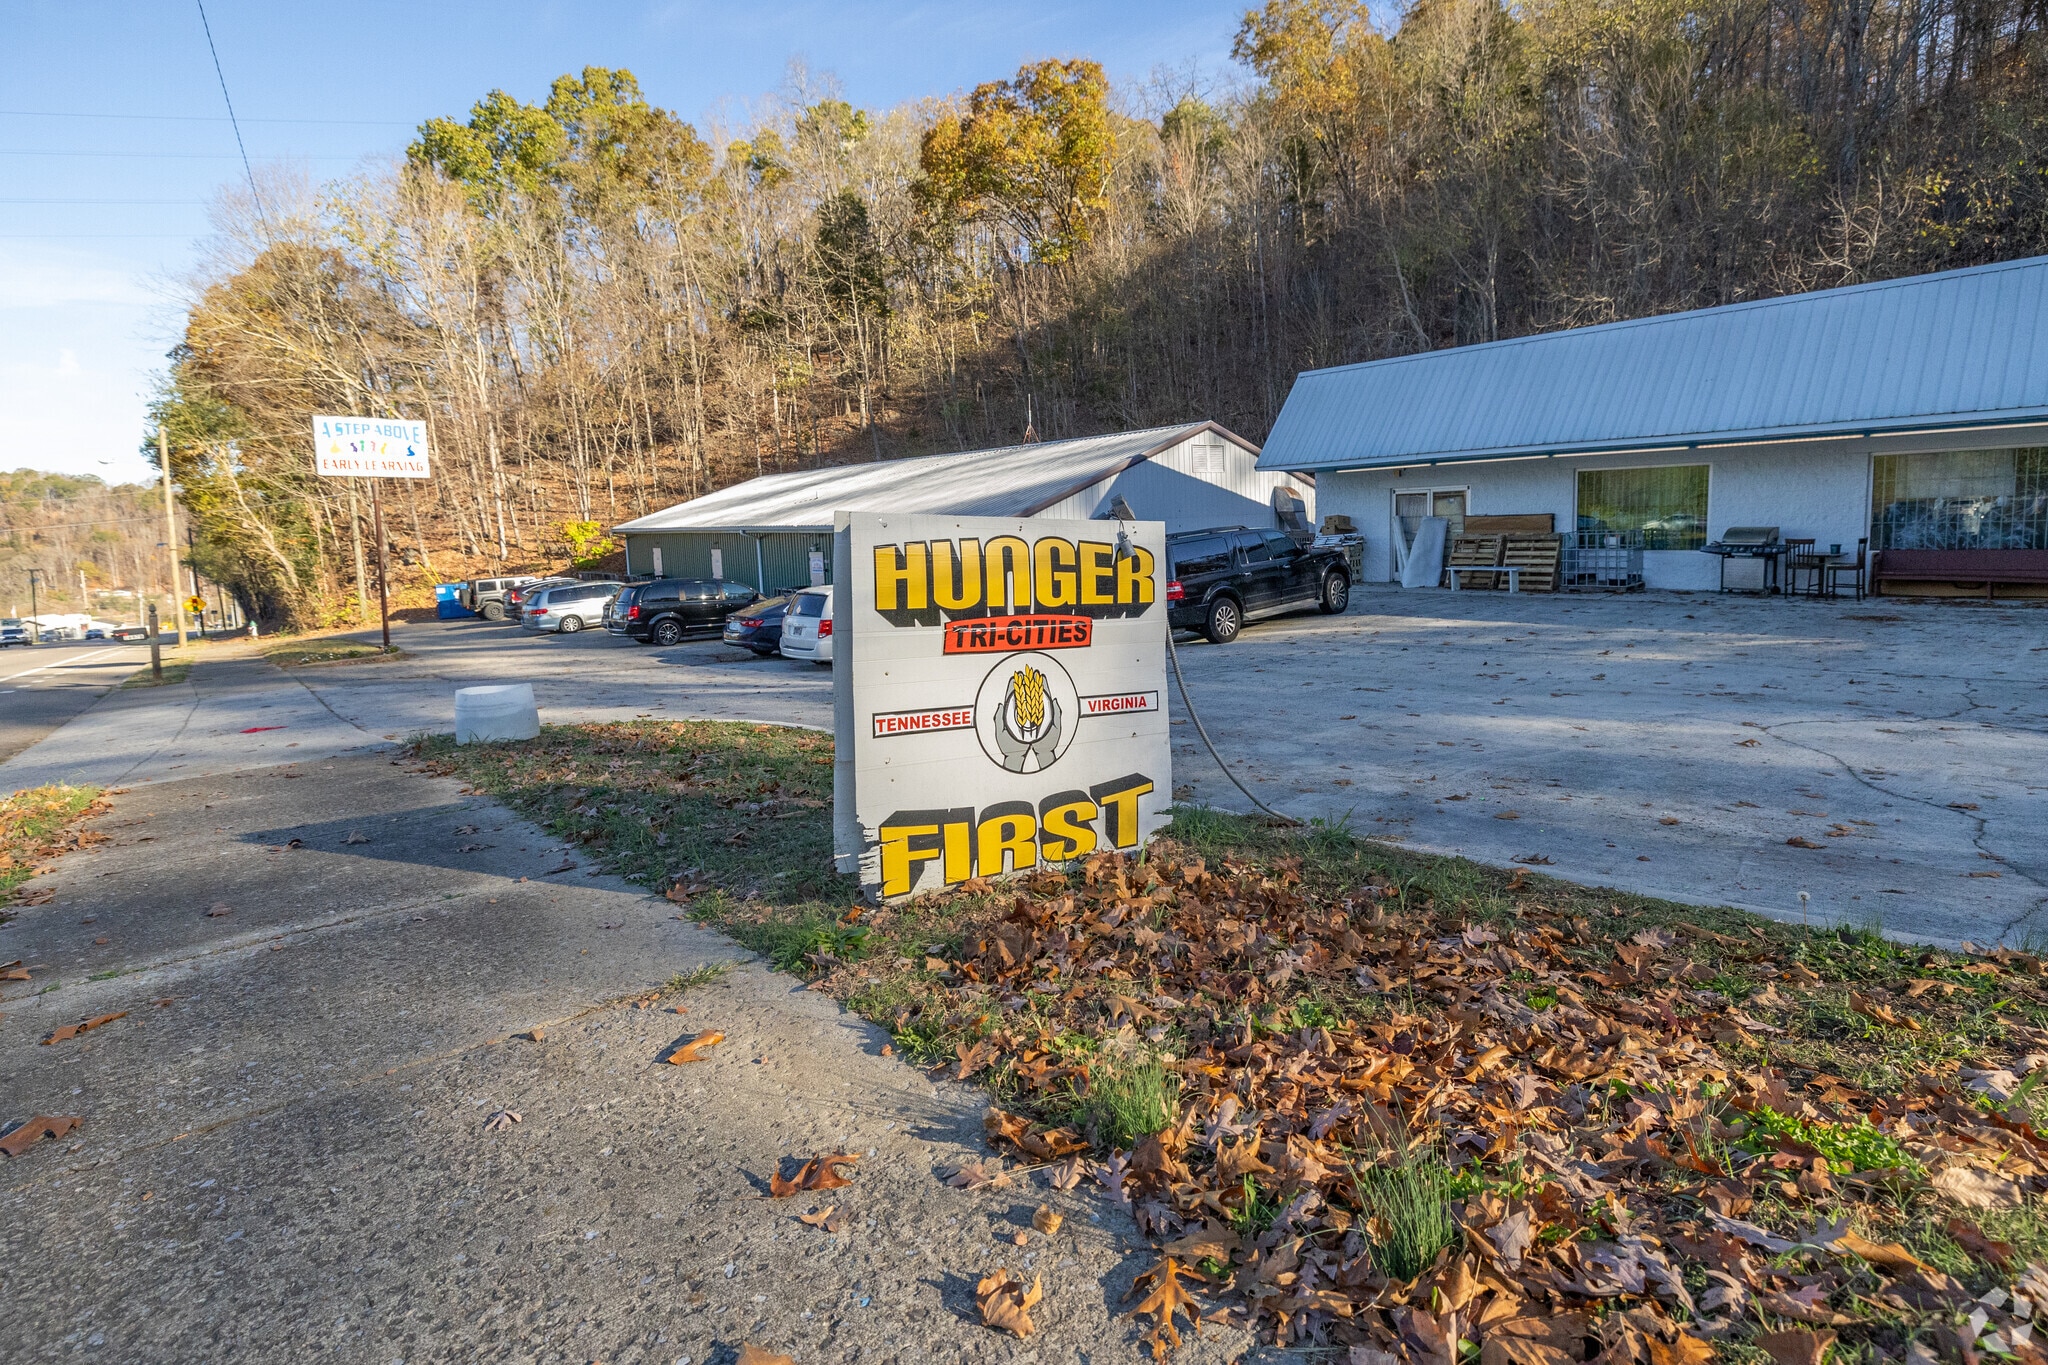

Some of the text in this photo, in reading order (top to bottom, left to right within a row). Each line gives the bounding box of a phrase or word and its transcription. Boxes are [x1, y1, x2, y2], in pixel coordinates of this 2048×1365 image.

[322, 422, 331, 438] A
[335, 422, 370, 436] STEP
[323, 459, 424, 472] EARLY LEARNING
[873, 534, 1155, 627] HUNGER
[952, 619, 1089, 648] TRI-CITIES
[1087, 695, 1148, 713] VIRGINIA
[875, 711, 971, 733] TENNESSEE
[879, 772, 1154, 898] FIRST
